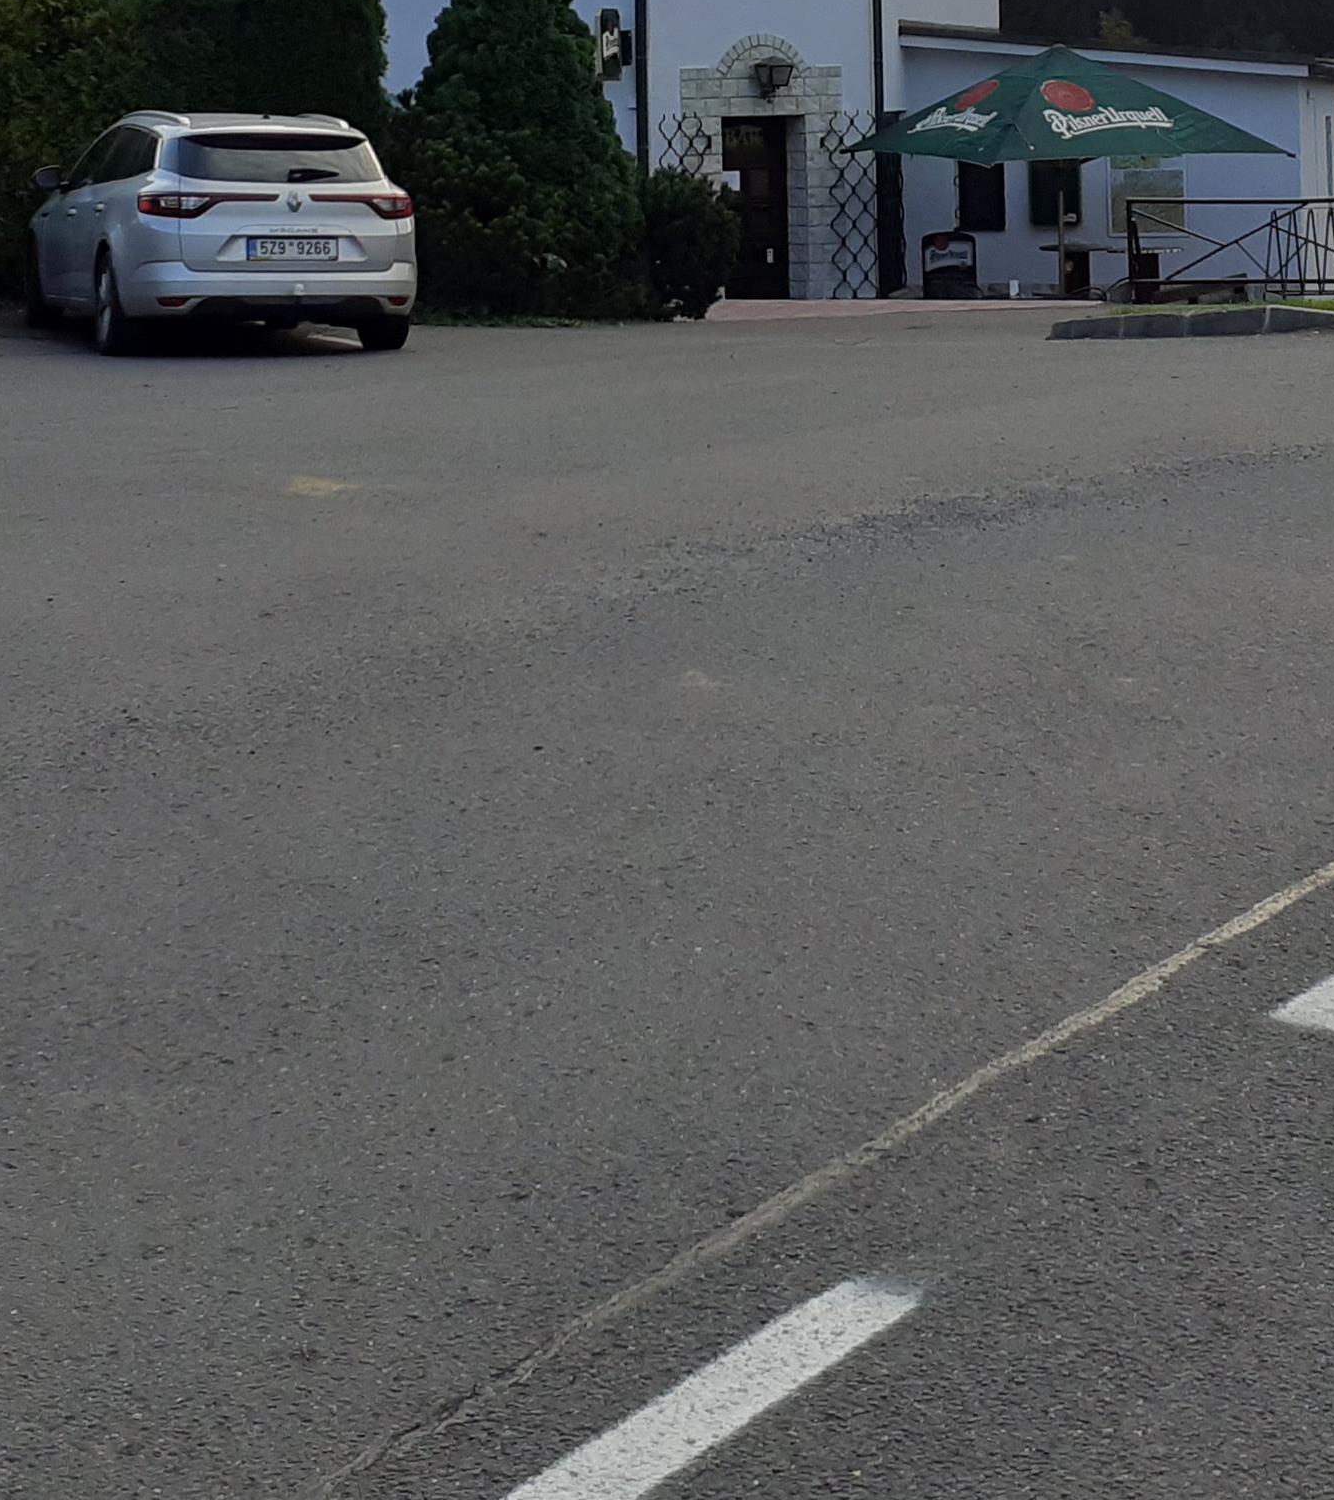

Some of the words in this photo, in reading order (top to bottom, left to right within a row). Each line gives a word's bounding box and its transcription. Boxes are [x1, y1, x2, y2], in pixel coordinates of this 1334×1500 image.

[1043, 109, 1109, 139] Pilsner
[1097, 106, 1169, 129] Urquell
[260, 241, 287, 256] 5Z9
[296, 241, 332, 256] 9266
